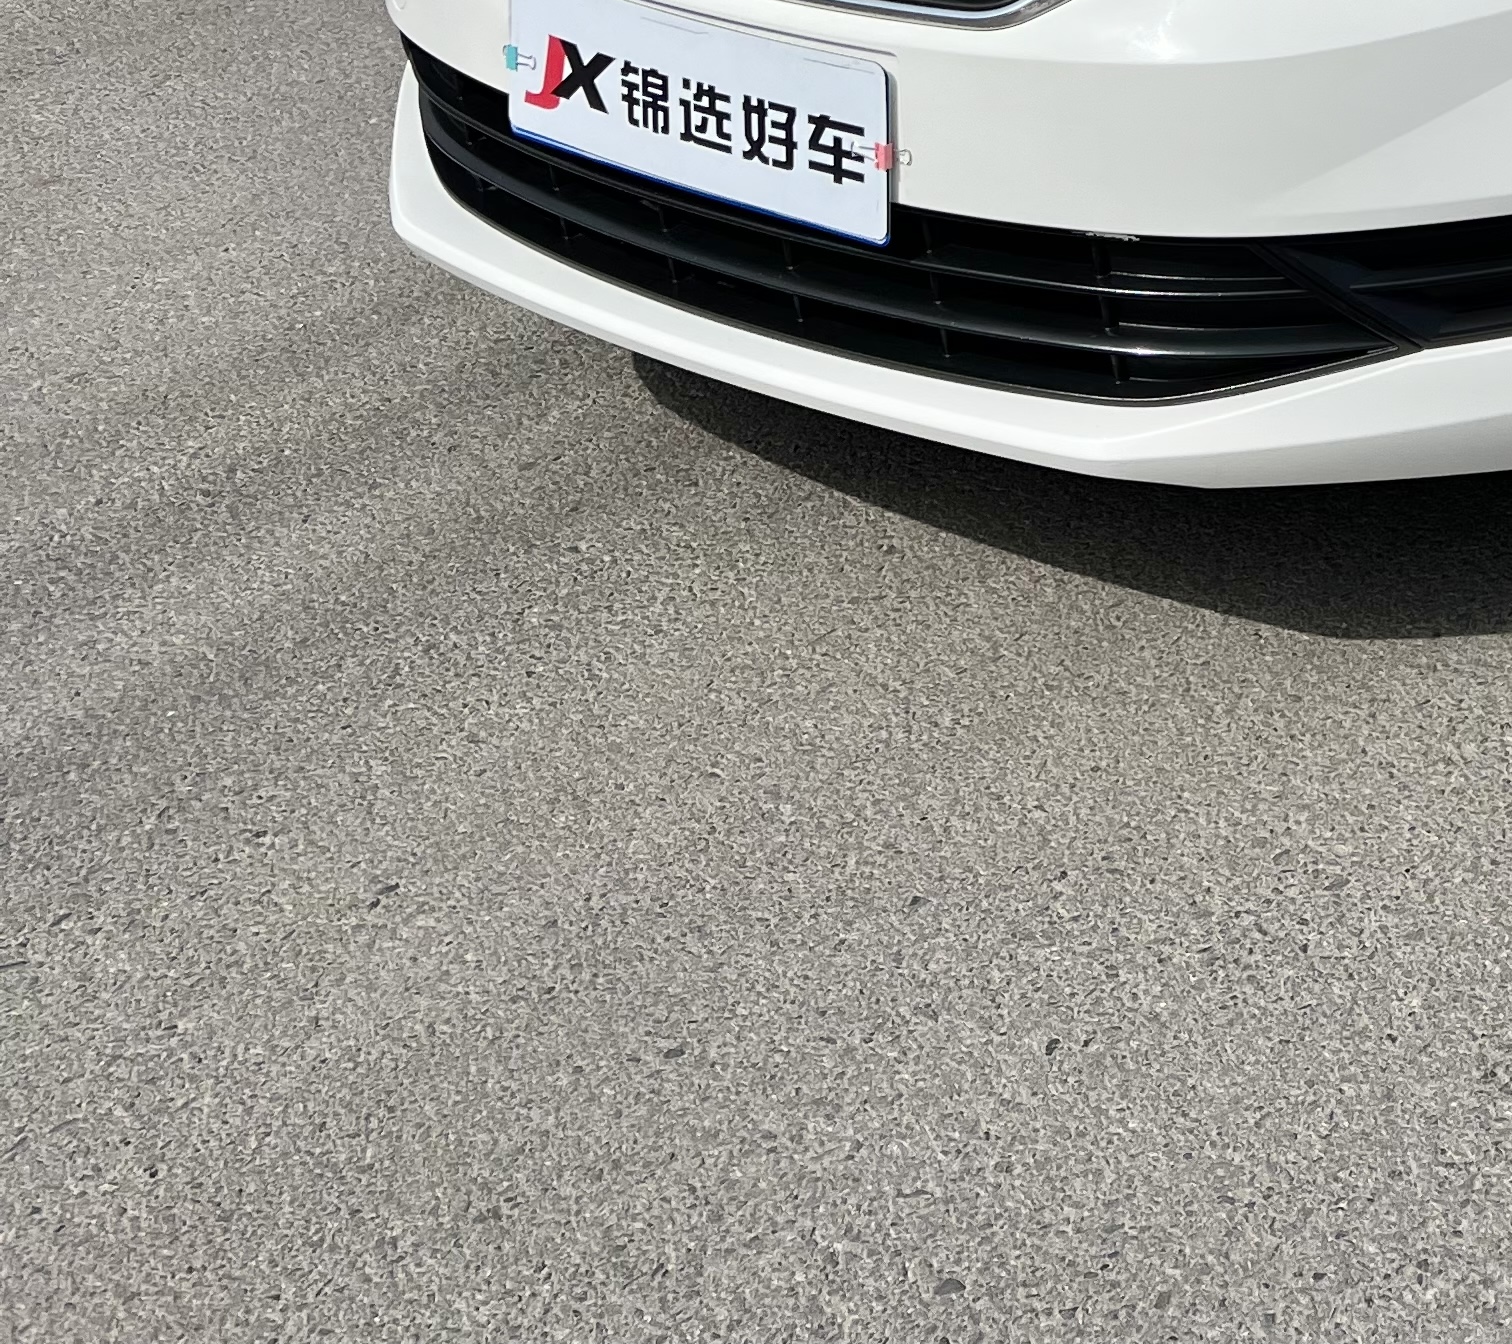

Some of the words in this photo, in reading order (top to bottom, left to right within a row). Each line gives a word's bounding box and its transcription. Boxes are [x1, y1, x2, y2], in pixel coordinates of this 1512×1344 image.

[524, 34, 616, 115] JX
[620, 59, 866, 186] 锦选好车
